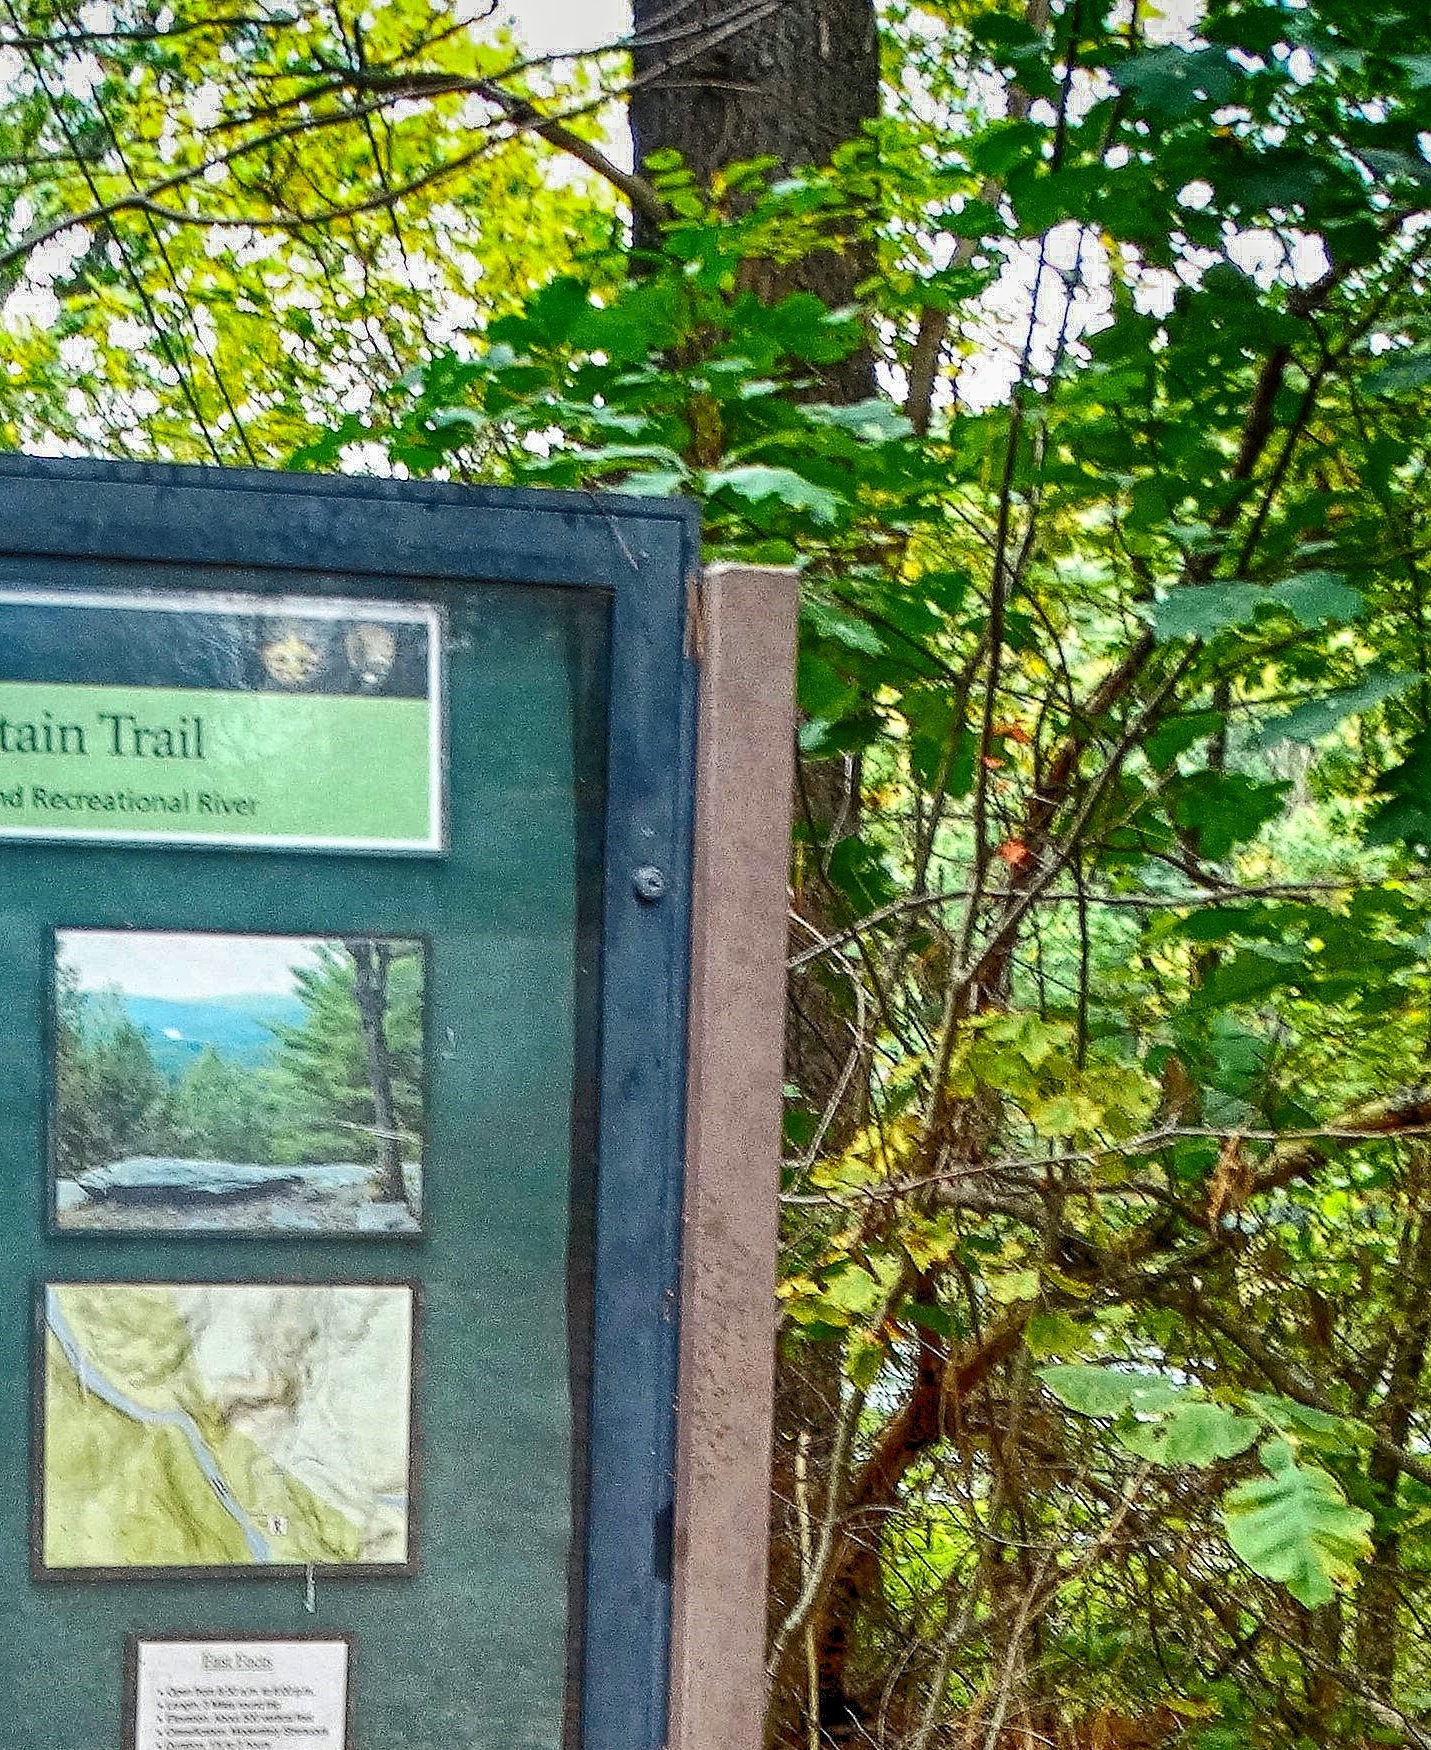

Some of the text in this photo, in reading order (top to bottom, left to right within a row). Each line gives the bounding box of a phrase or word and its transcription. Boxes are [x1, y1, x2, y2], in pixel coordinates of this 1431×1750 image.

[98, 711, 207, 761] Trail
[33, 787, 190, 815] Recreational
[199, 792, 260, 817] River
